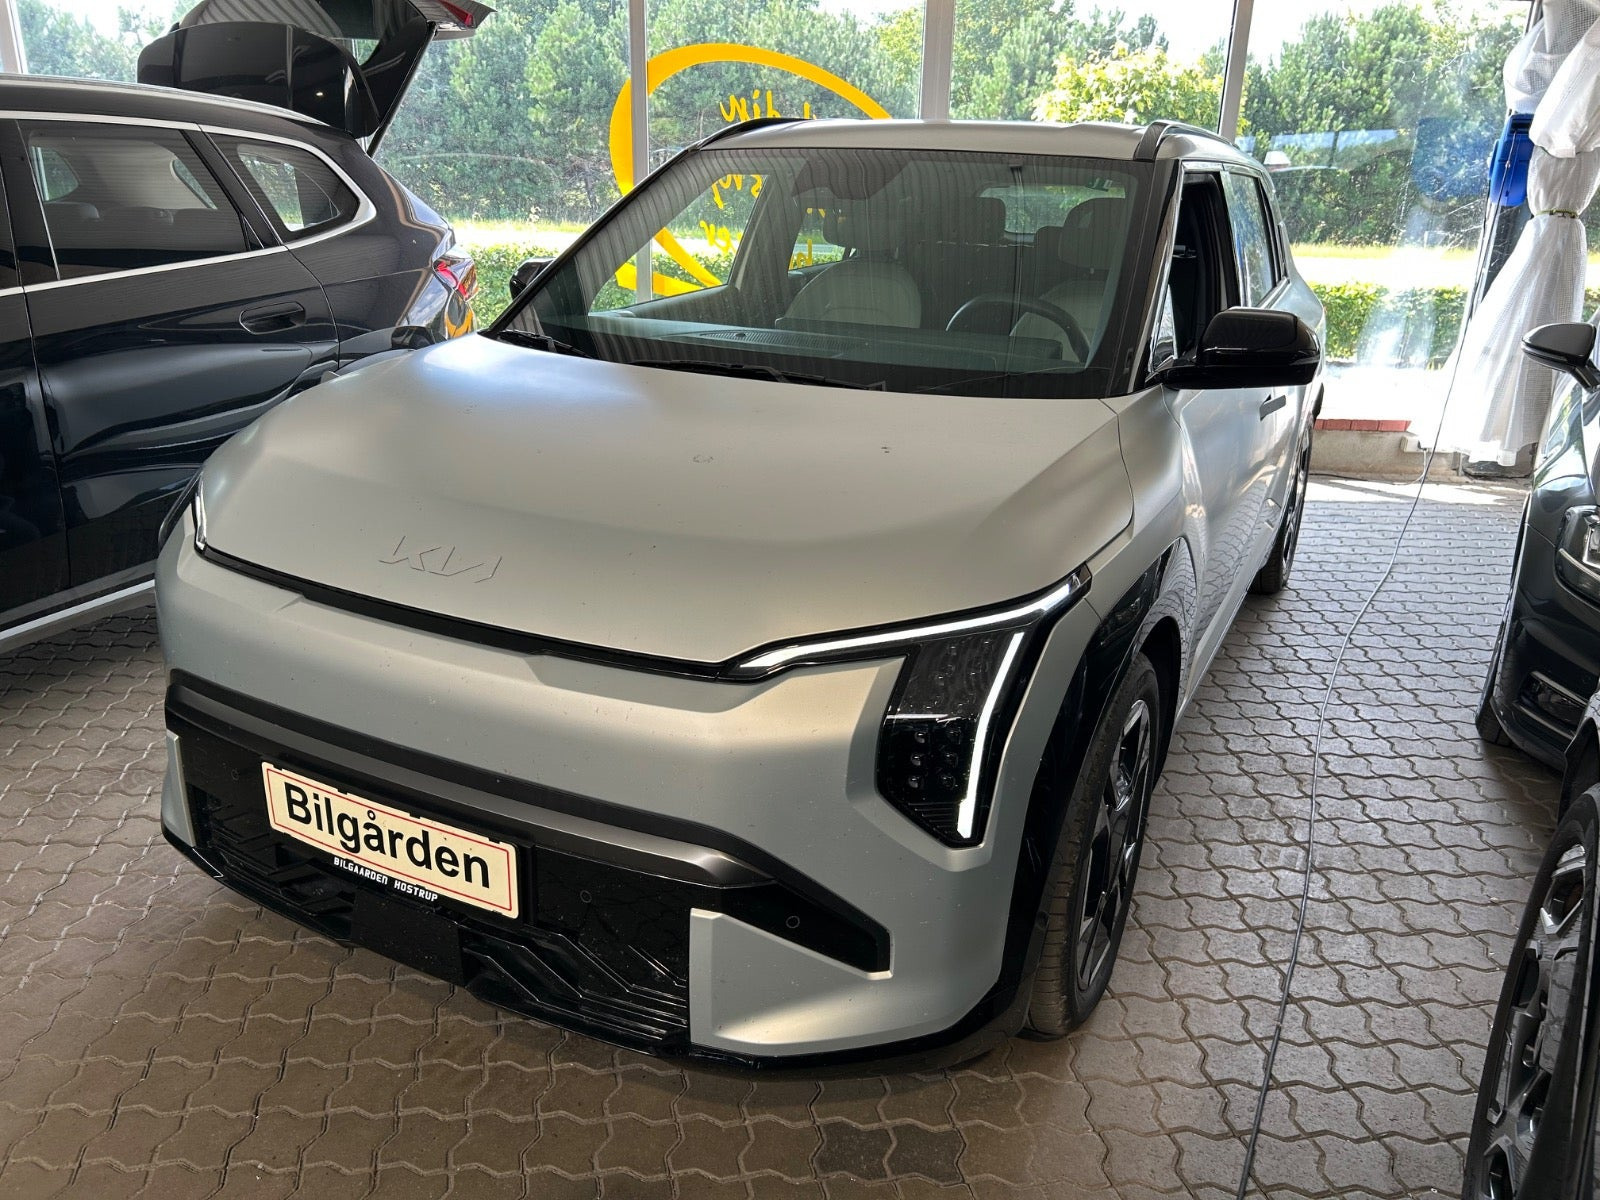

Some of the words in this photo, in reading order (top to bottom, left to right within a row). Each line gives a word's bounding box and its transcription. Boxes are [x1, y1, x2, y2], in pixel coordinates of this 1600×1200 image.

[284, 781, 490, 889] Bilgården
[333, 856, 388, 885] BILGAARDEN
[394, 880, 438, 902] HOSTRUP
